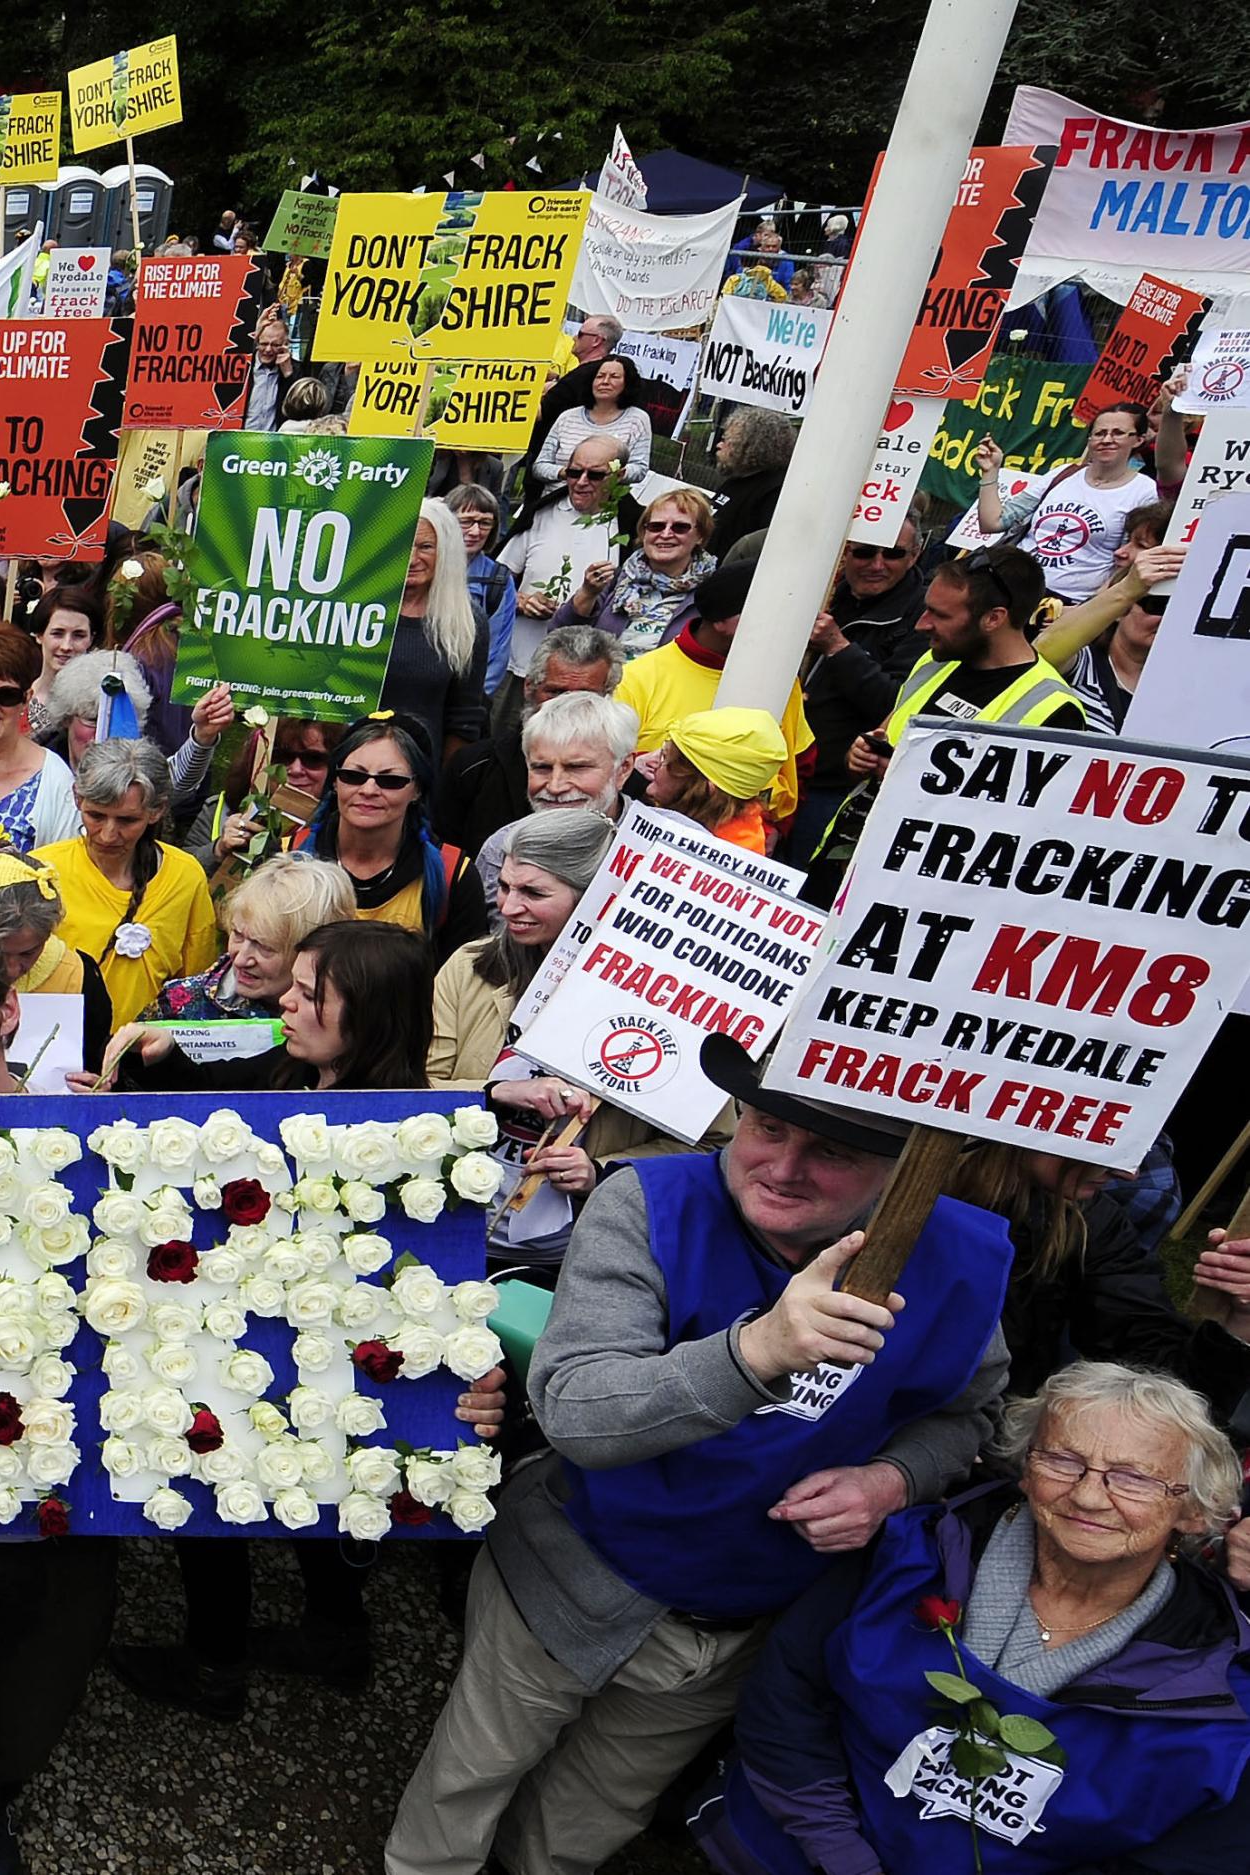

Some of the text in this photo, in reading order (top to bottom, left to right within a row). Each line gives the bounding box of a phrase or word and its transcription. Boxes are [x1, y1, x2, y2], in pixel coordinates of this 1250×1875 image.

[78, 58, 172, 105] DON'T FRACK
[74, 81, 176, 129] YORK SHIRE
[8, 114, 54, 136] FRACK
[3, 139, 54, 168] SHIRE
[1090, 180, 1250, 239] MALTO
[58, 262, 75, 271] We
[346, 234, 434, 269] DON'T
[463, 234, 569, 270] FRACK
[52, 272, 103, 283] Ryedale
[143, 282, 222, 299] THE CLIMATE
[144, 264, 220, 281] RISE UP FOR
[1136, 280, 1154, 297] RISE
[50, 295, 99, 306] frack
[54, 306, 92, 317] free
[331, 272, 555, 331] YORK SHIRE
[915, 288, 1000, 328] KING
[1144, 300, 1177, 326] CLIMATE
[3, 331, 27, 353] UP
[31, 331, 66, 353] FOR
[137, 324, 202, 352] NO TO
[766, 309, 816, 349] We're
[1107, 331, 1149, 367] NO TO
[133, 354, 247, 383] FRACKING
[704, 341, 807, 410] NOT Backing
[1094, 358, 1162, 405] FRACKING
[444, 390, 531, 423] SHIRE
[5, 416, 44, 453] TO
[222, 455, 410, 488] Green Party
[875, 461, 911, 477] stay
[1039, 503, 1105, 534] FRACK FREE
[246, 507, 351, 594] NO
[194, 587, 386, 648] FRACKING
[185, 676, 366, 704] FIGHT join.greenparty.org.uk
[947, 700, 965, 713] IN
[920, 738, 1185, 825] SAY NO
[631, 815, 674, 846] THIRD
[678, 838, 741, 875] ENERGY
[745, 865, 790, 892] HAVE
[649, 852, 688, 884] WE
[689, 870, 770, 919] WON'T
[883, 817, 1250, 929] FRACKING
[571, 922, 593, 944] TO
[630, 880, 812, 977] FOR POLITICIANS
[613, 908, 795, 1007] WHO CONDONE
[837, 902, 1211, 1028] AT KM8
[582, 942, 765, 1052] FRACKING
[609, 1015, 678, 1056] FRACK FREE
[817, 986, 1167, 1088] KEEP RYEDALE
[588, 1061, 642, 1093] RYEDALE
[796, 1039, 1133, 1146] FRACK FREE
